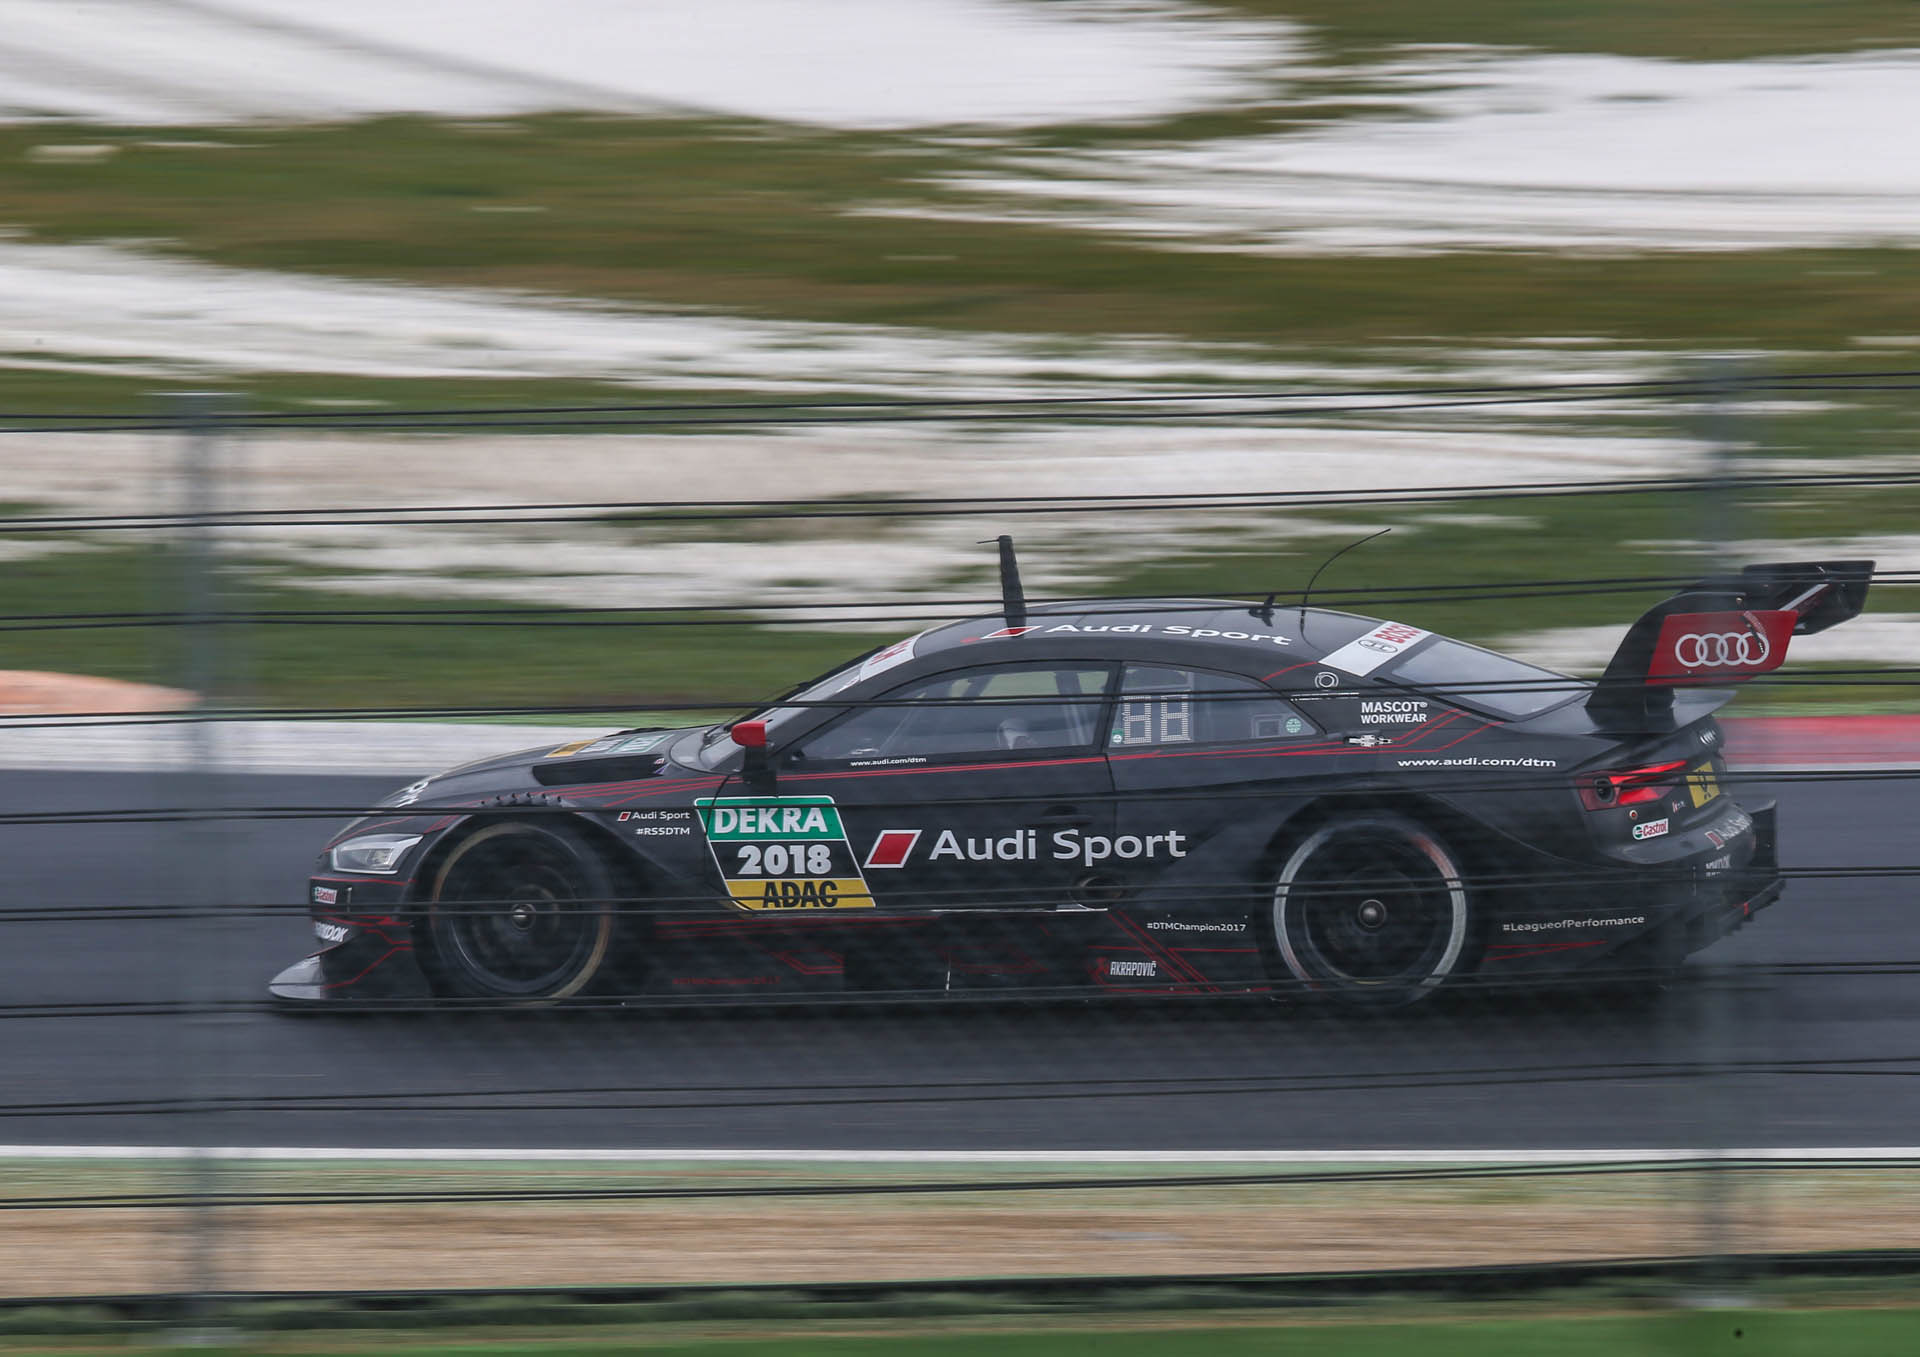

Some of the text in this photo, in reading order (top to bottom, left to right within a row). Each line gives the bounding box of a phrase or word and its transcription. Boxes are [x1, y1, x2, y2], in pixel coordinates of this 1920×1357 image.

[1045, 624, 1293, 646] Audi Sport
[1360, 713, 1427, 724] WORKWEAR
[850, 757, 927, 767] www.audi.com/dtm
[1397, 757, 1557, 768] www.audi.com/dtm
[632, 811, 691, 821] Audi Sport
[714, 807, 829, 834] DEKRA
[1643, 820, 1667, 836] Castrol
[928, 828, 1187, 867] Audi Sport
[737, 844, 832, 875] 2018
[762, 880, 838, 909] ADAC
[1146, 922, 1247, 932] #DTMChampion2017
[1502, 915, 1646, 932] #LeagueofPerformance
[1109, 960, 1157, 977] AKRAPOVIČ
